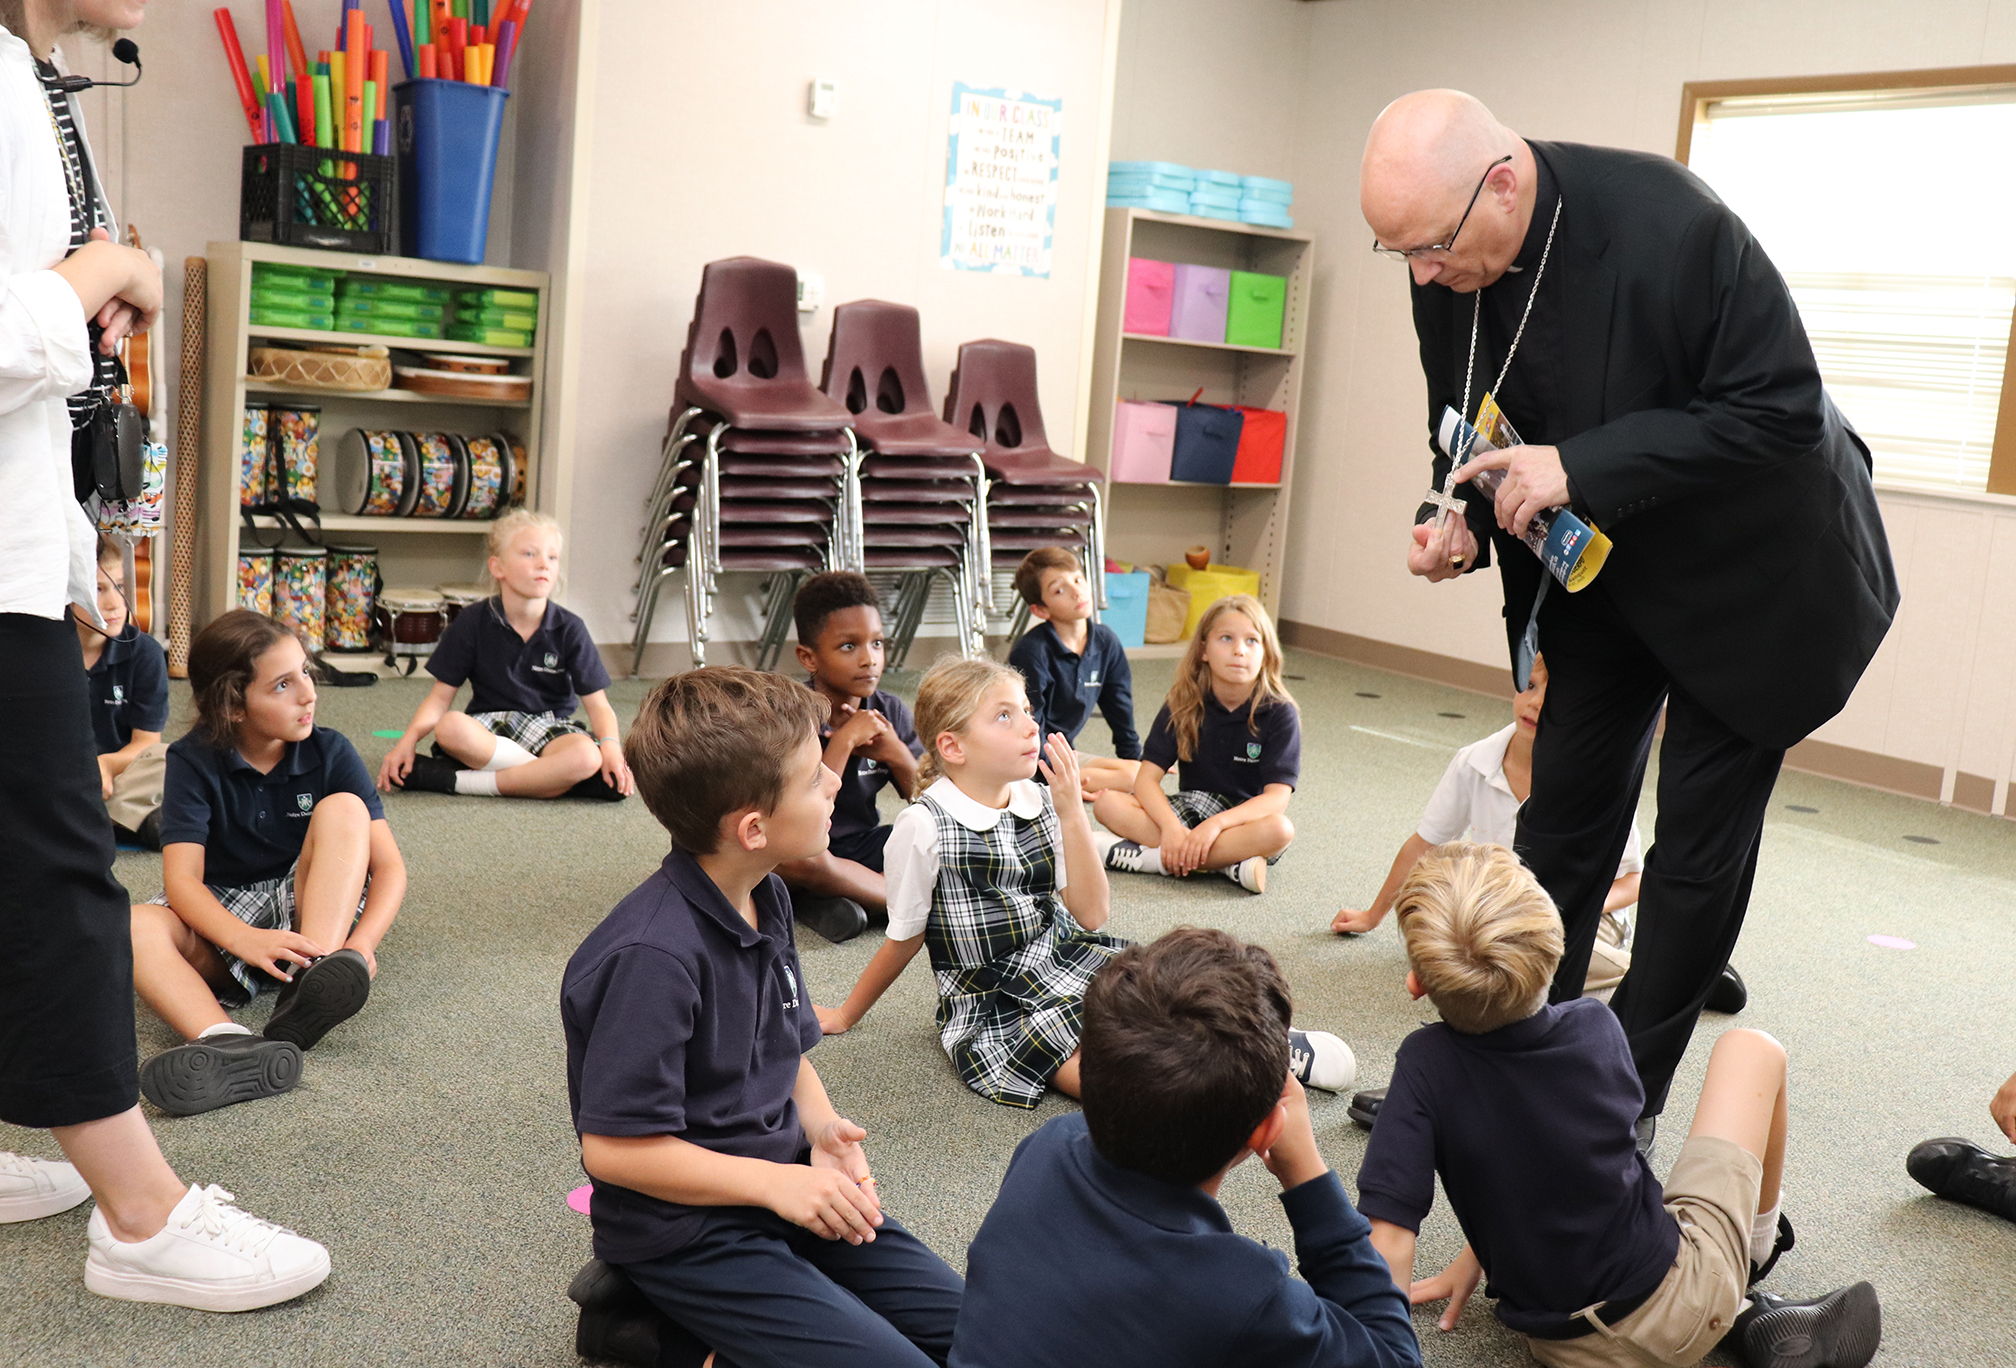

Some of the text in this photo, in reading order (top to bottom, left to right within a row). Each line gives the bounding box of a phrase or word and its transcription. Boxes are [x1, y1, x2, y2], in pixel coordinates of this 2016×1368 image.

[966, 100, 1049, 128] IN OUR CLASS
[1002, 127, 1035, 145] TEAM
[971, 161, 1018, 182] RESPECT
[976, 183, 1000, 199] kind
[1010, 186, 1045, 204] honest
[976, 203, 1034, 221] Work Hard
[954, 241, 1039, 263] WE ALL MATTER
